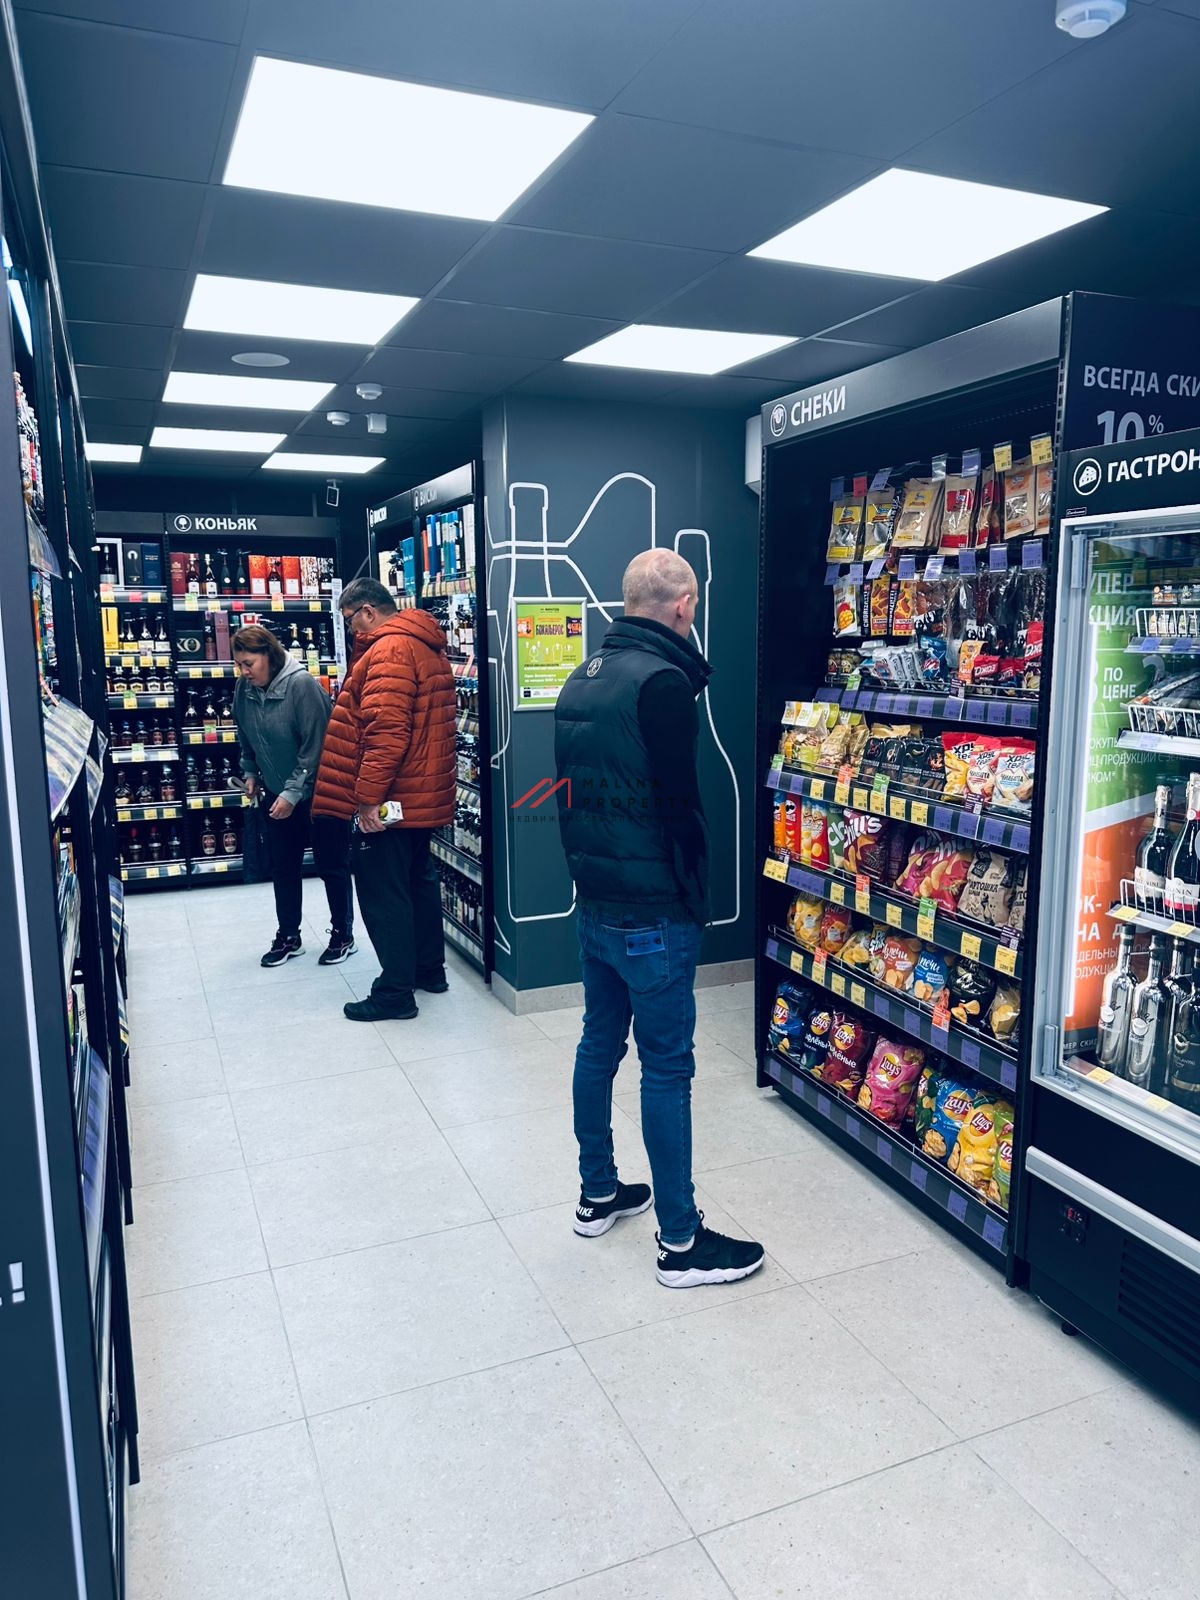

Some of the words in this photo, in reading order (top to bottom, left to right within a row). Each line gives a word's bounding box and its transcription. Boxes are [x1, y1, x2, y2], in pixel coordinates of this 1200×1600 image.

[1083, 365, 1159, 397] ВСЕГДА
[791, 385, 846, 426] СНЕКИ
[195, 517, 257, 531] КОНЬЯК
[1104, 667, 1123, 682] ПО
[1102, 684, 1136, 703] ЦЕНЕ
